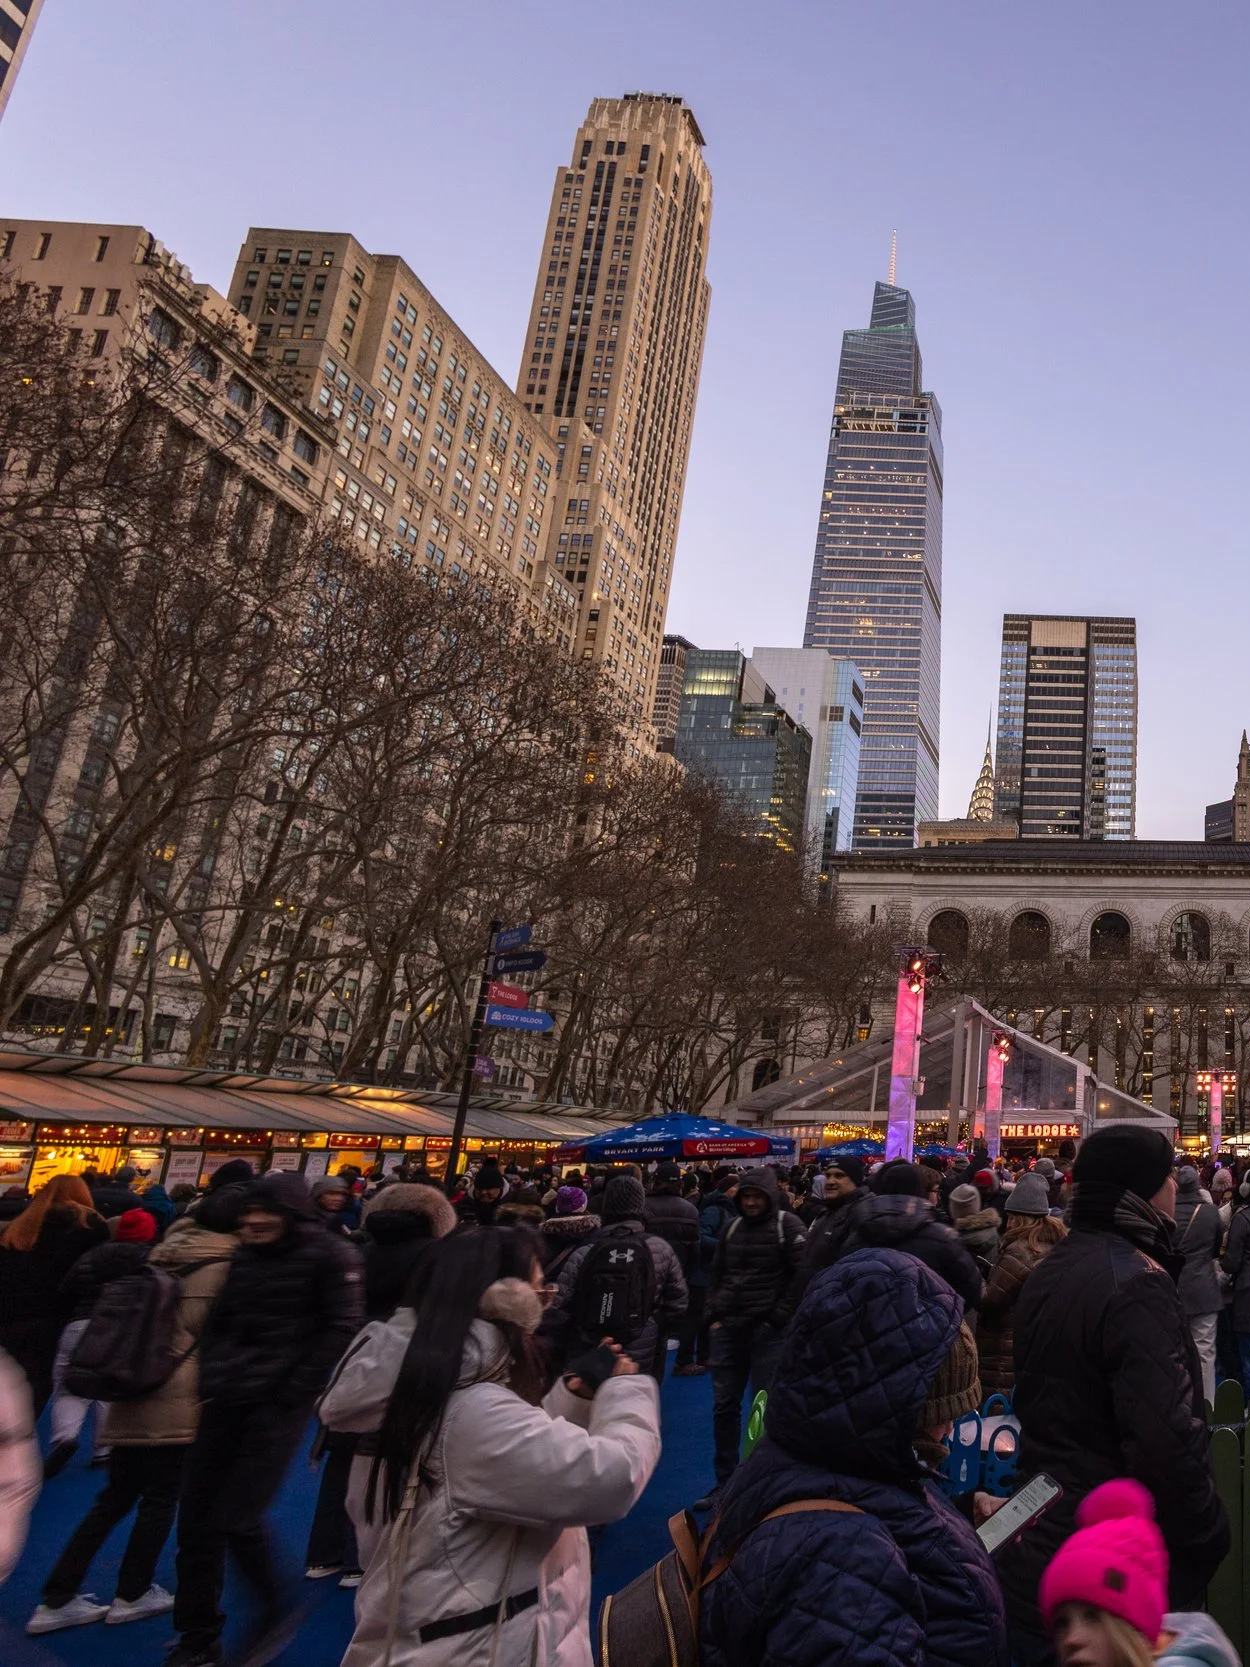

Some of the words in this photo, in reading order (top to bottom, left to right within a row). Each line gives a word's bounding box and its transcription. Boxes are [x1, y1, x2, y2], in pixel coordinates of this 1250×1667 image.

[497, 990, 505, 998] THE
[502, 1013, 519, 1021] COZY
[520, 1016, 543, 1025] IGLOOS
[1000, 1125, 1024, 1136] THE
[1028, 1125, 1066, 1136] LODGE
[606, 1292, 614, 1317] UNDER
